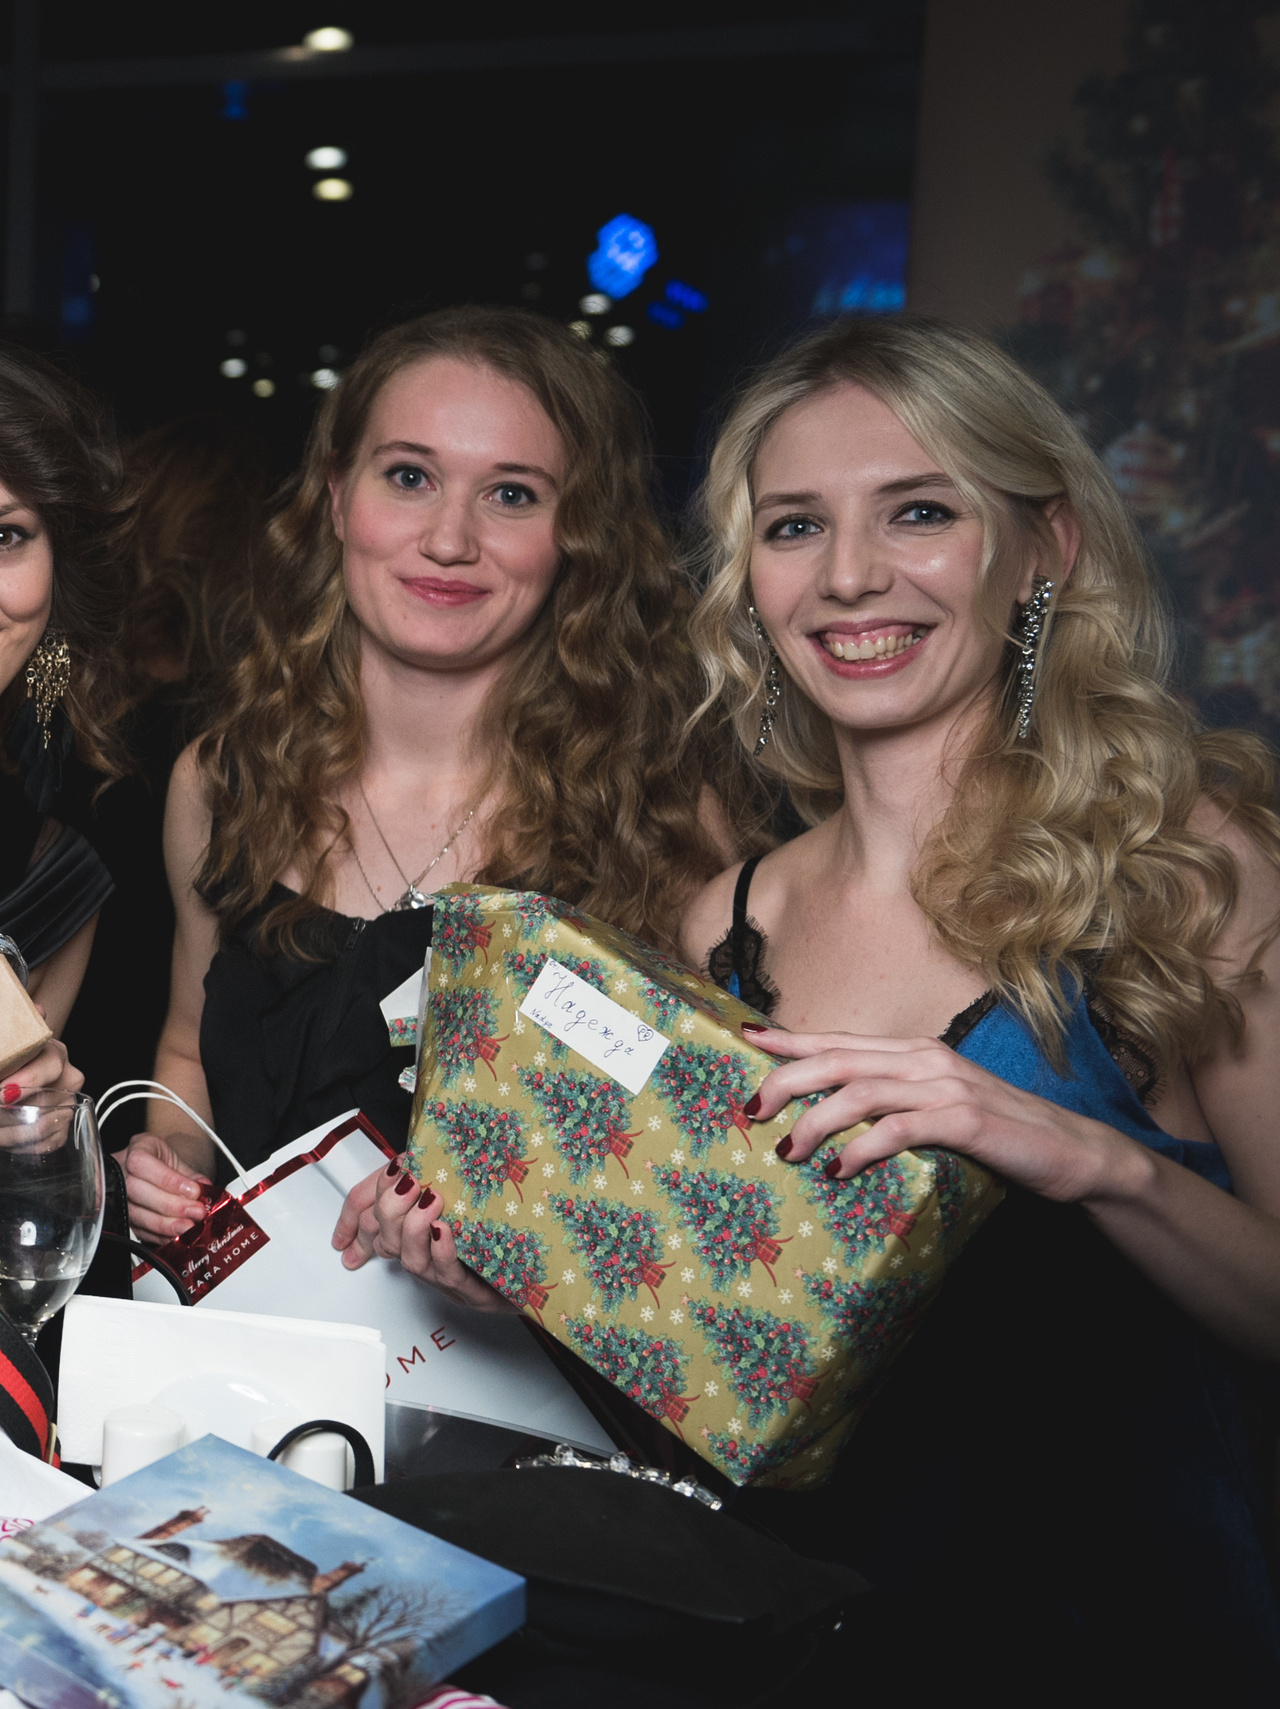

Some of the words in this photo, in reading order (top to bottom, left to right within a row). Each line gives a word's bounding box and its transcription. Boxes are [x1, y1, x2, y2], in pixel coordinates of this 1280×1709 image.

[545, 972, 634, 1058] Надежда
[182, 1254, 210, 1278] Merry
[207, 1224, 244, 1253] Christmas
[187, 1266, 221, 1294] ZARA
[223, 1231, 259, 1264] HOME
[385, 1326, 456, 1389] ME
